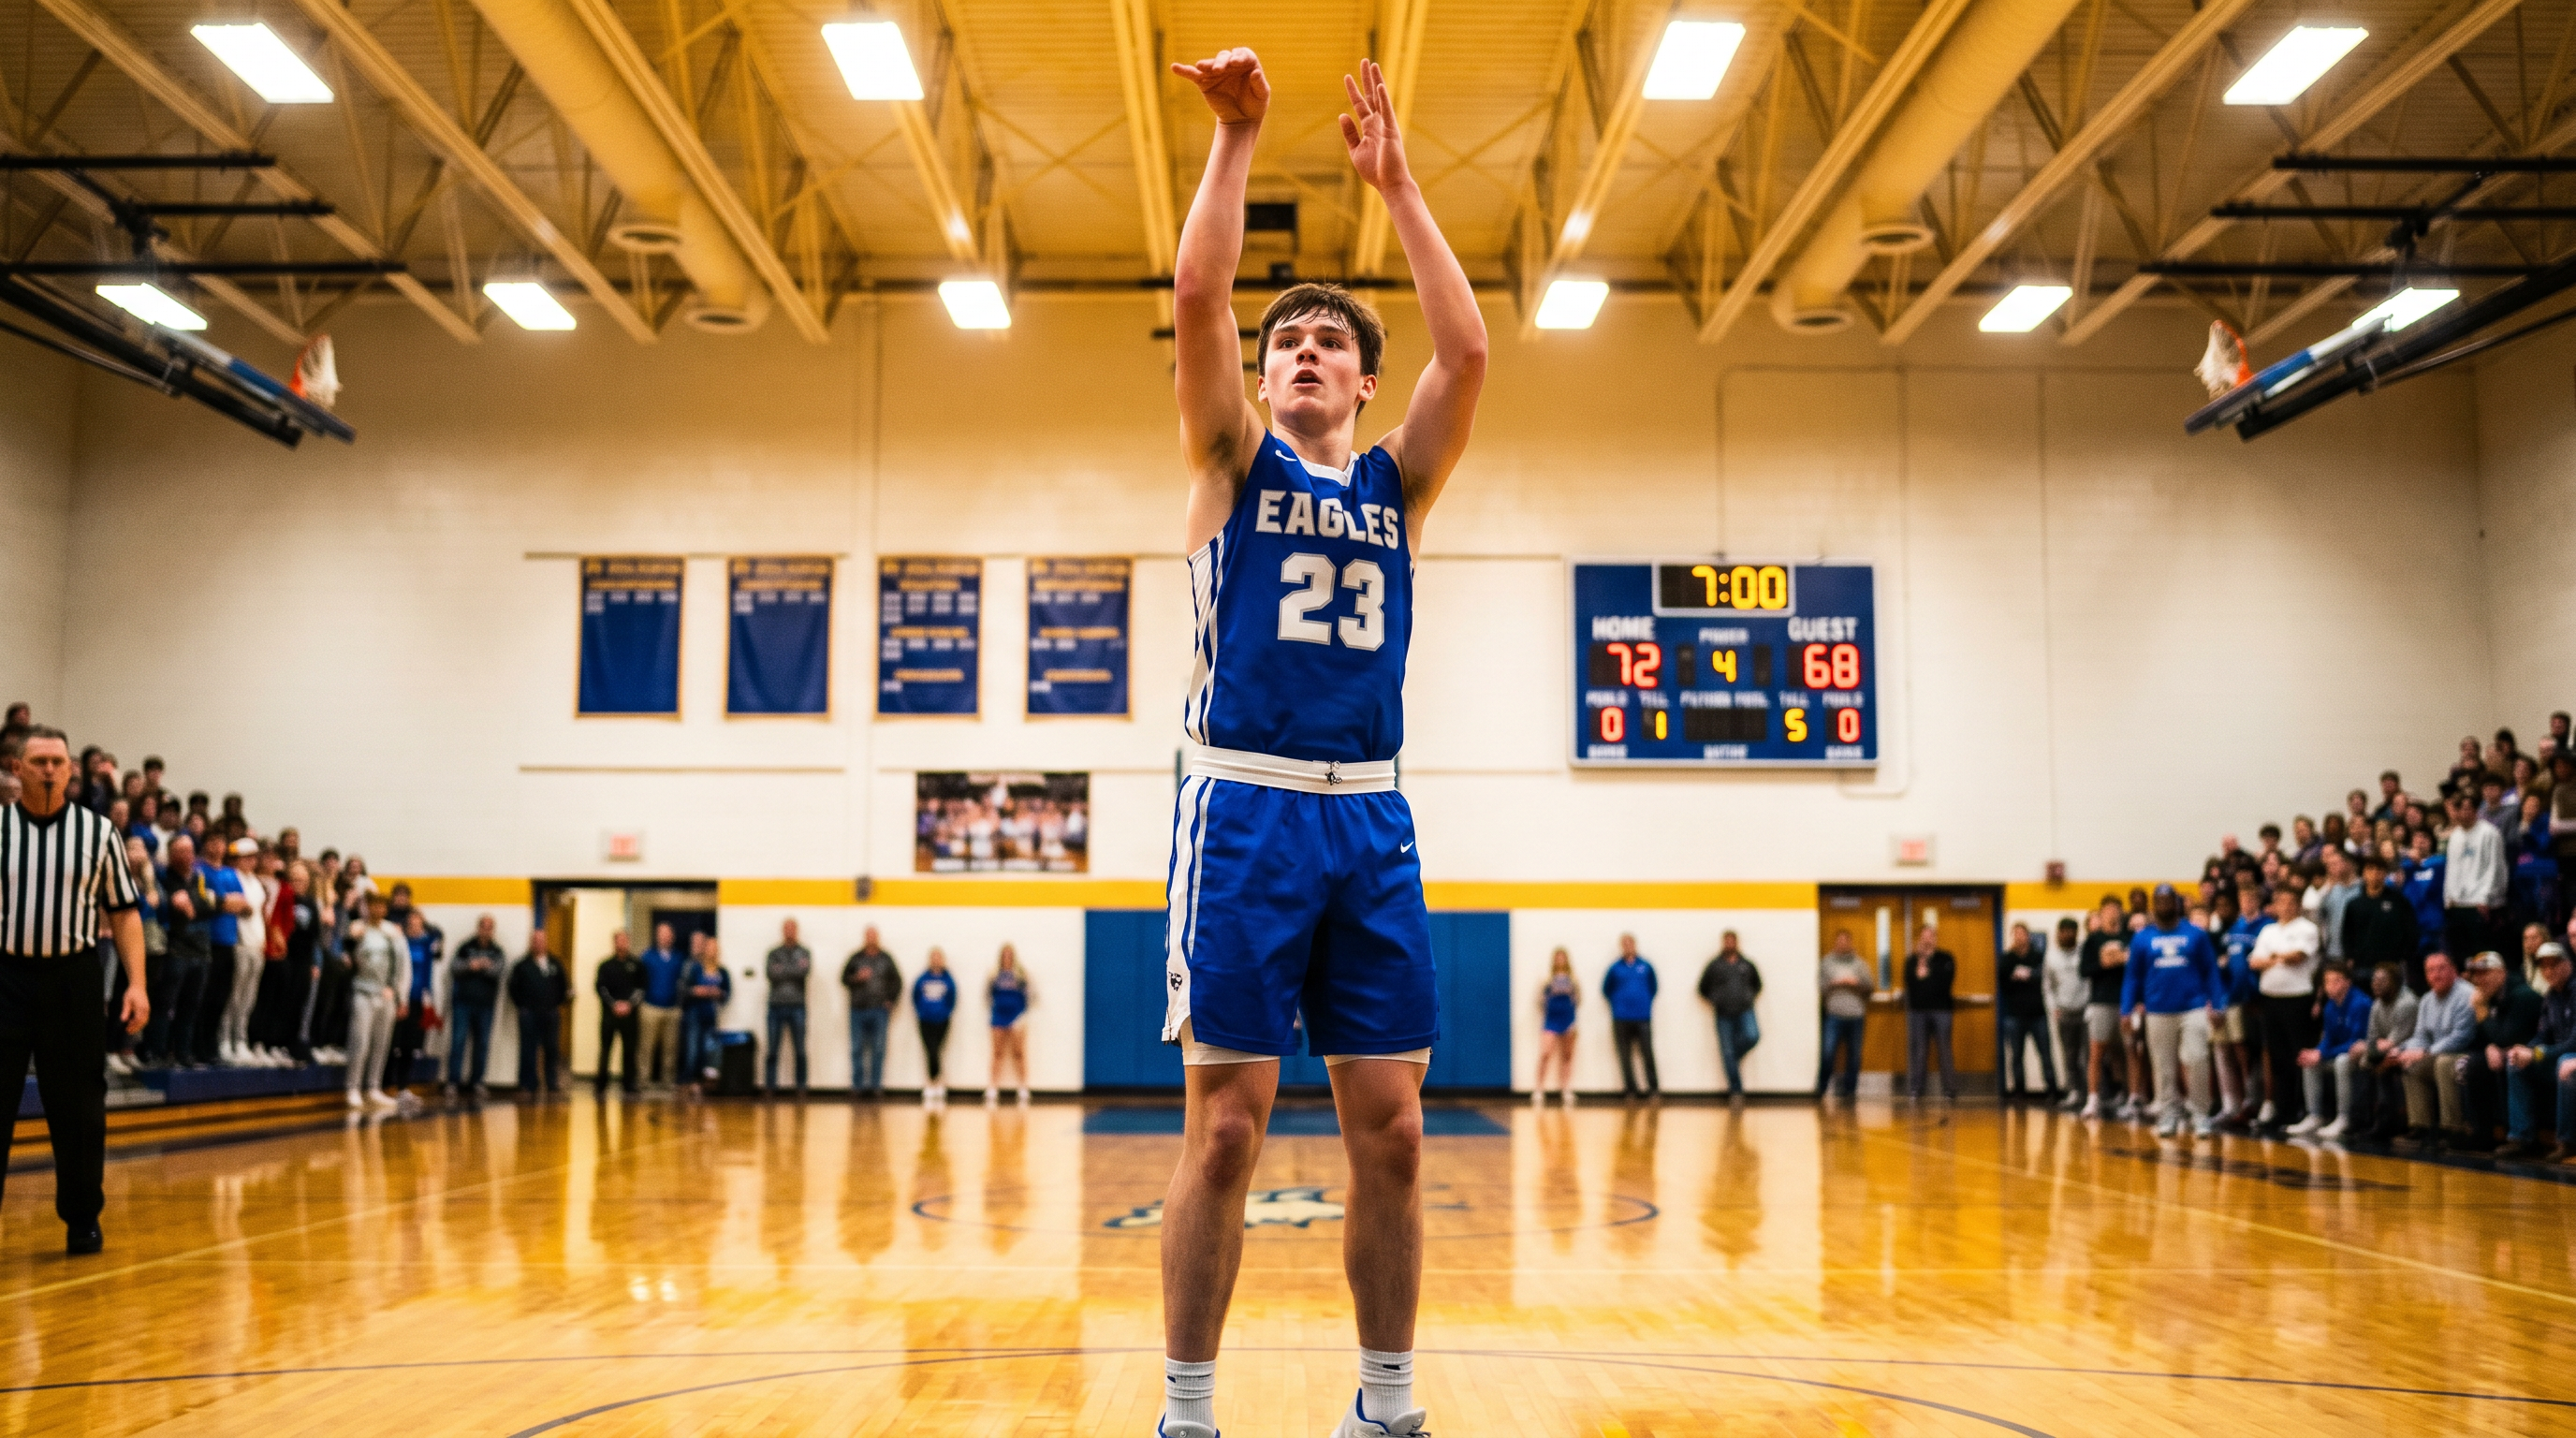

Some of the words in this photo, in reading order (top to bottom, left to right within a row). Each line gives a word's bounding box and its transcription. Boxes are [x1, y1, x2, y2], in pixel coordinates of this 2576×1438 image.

[1255, 489, 1399, 550] EAGLES
[1277, 551, 1385, 652] 23
[1691, 565, 1787, 609] 7:00
[1788, 616, 1858, 641] GUEST
[1606, 642, 1661, 689] 72
[1712, 650, 1737, 683] 4
[1803, 643, 1860, 689] 68
[1601, 706, 1625, 742] 0
[1837, 708, 1861, 743] 0
